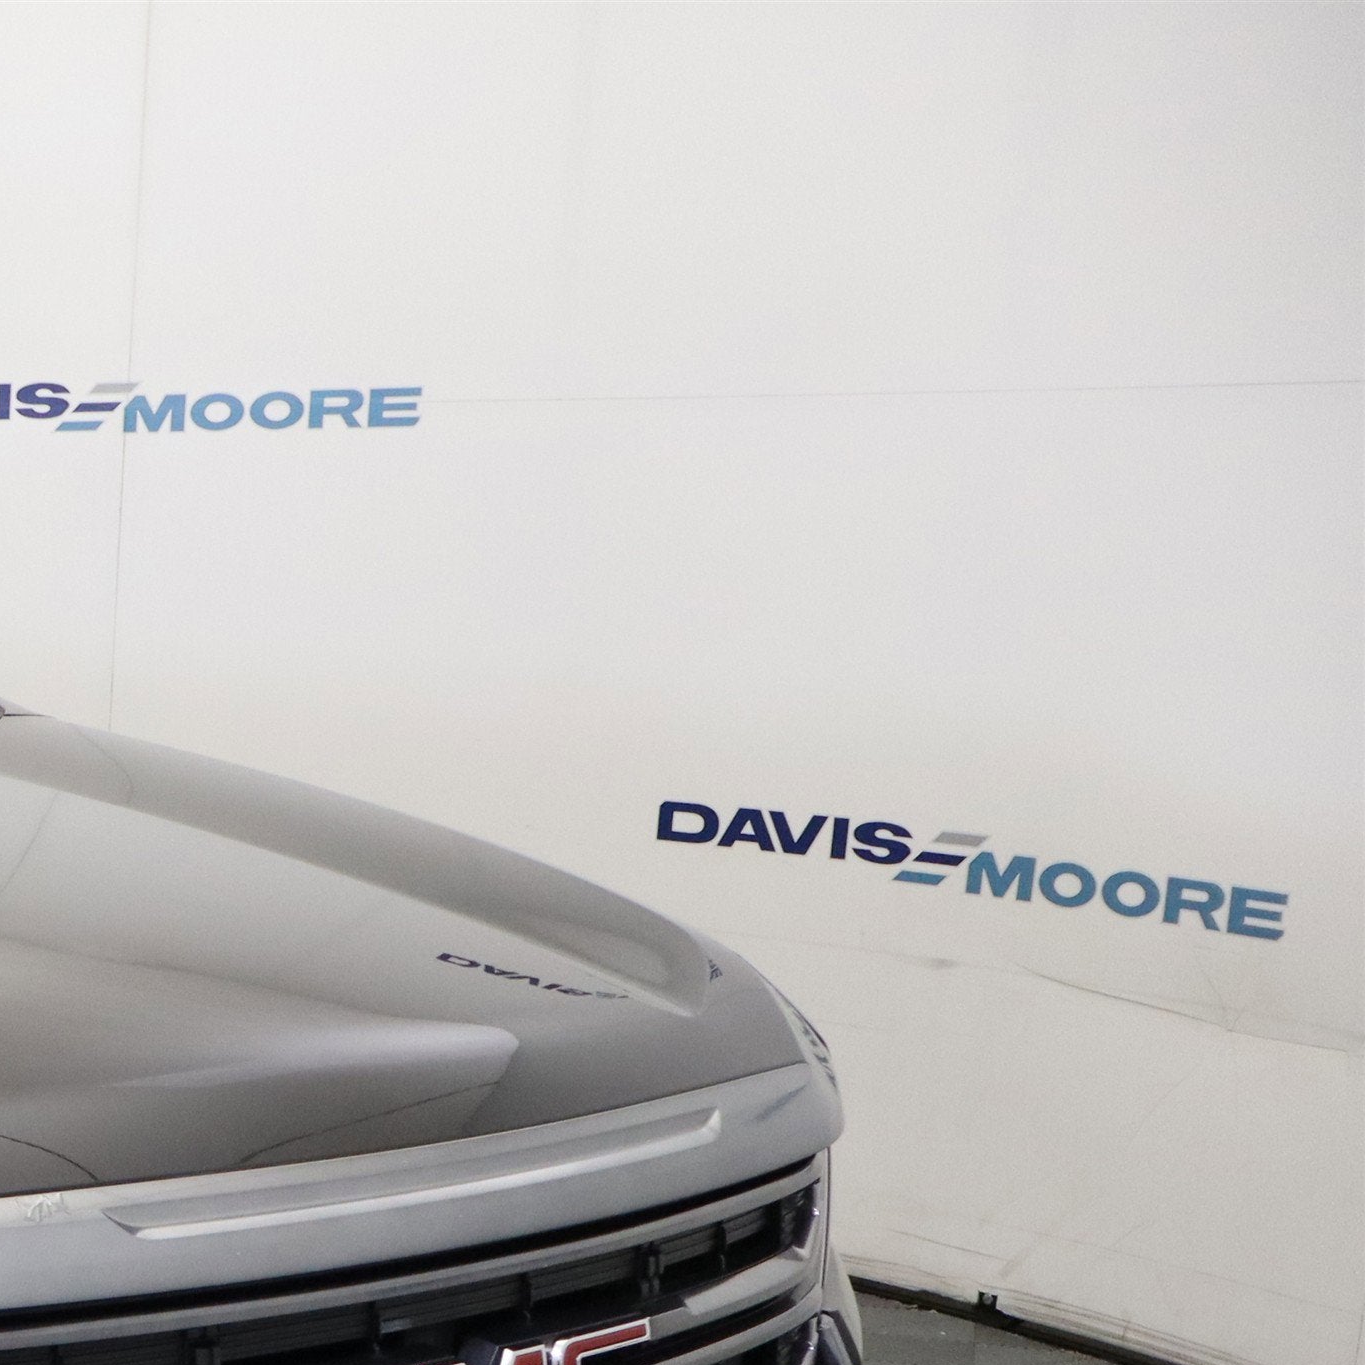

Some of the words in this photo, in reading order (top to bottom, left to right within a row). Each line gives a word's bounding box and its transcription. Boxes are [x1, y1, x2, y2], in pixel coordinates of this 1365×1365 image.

[122, 386, 423, 433] MOORE
[656, 800, 913, 866] DAVIS
[965, 850, 1289, 941] MOORE
